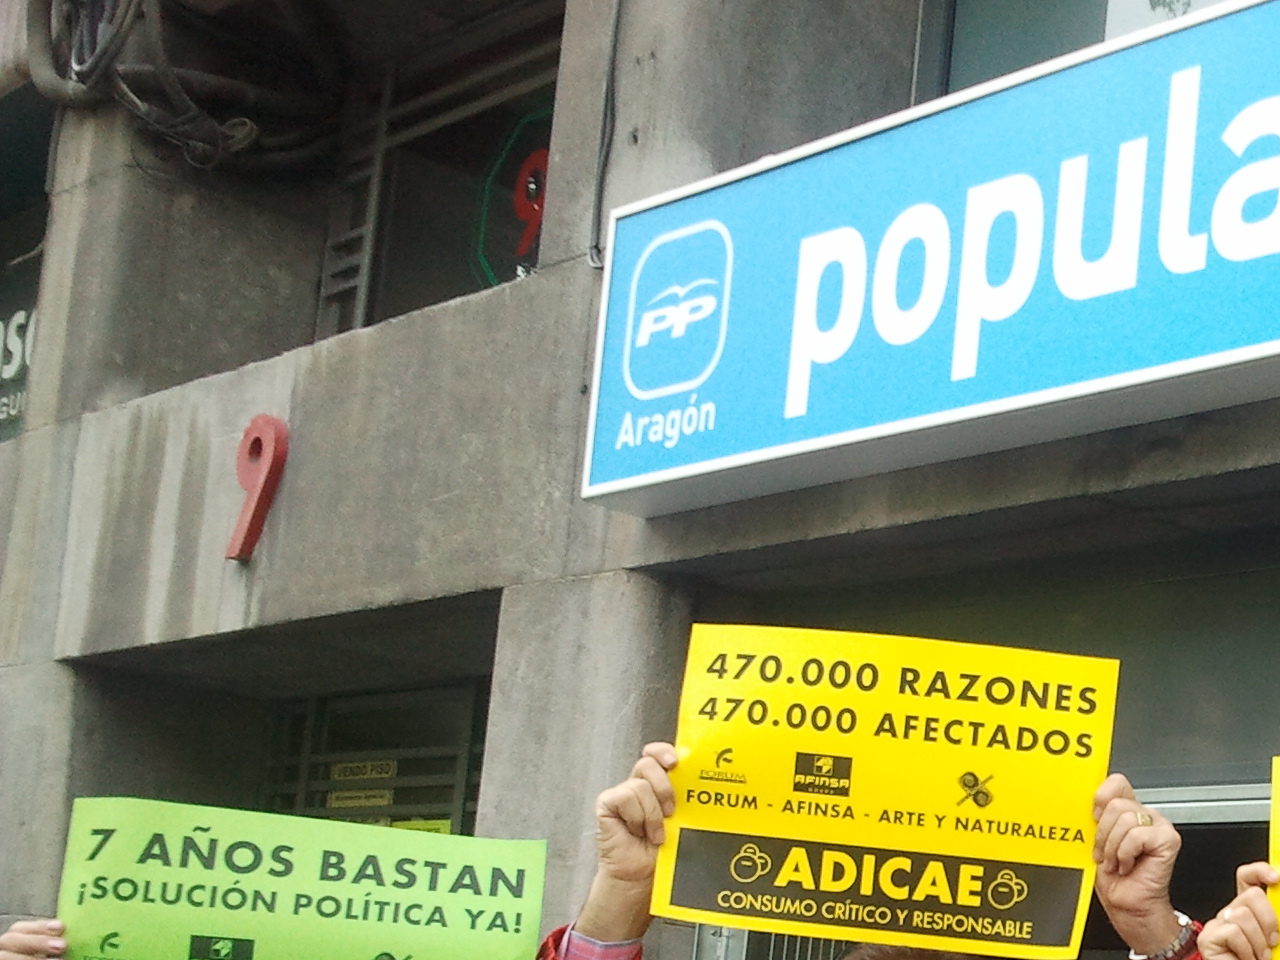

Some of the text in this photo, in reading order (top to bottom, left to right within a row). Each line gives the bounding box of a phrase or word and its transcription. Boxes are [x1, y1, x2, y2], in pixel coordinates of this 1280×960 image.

[635, 295, 717, 347] PP
[615, 393, 716, 450] Aragón
[226, 414, 289, 562] 9
[707, 653, 1097, 715] 470.000 RAZONES
[698, 697, 1093, 758] 470.000 AFECTADOS
[686, 789, 758, 810] FORUM
[782, 799, 855, 820] AFINSA
[878, 809, 926, 827] ARTE
[934, 814, 946, 828] Y
[954, 816, 1086, 843] NATURALEZA
[85, 826, 526, 898] 7 AÑOS BASTAN
[773, 847, 984, 907] ADICAE
[77, 876, 523, 933] ¡SOLUCIÓN POLÍTICA YA!
[717, 890, 1033, 939] CONSUMO CRÍTICO Y RESPONSABLE
